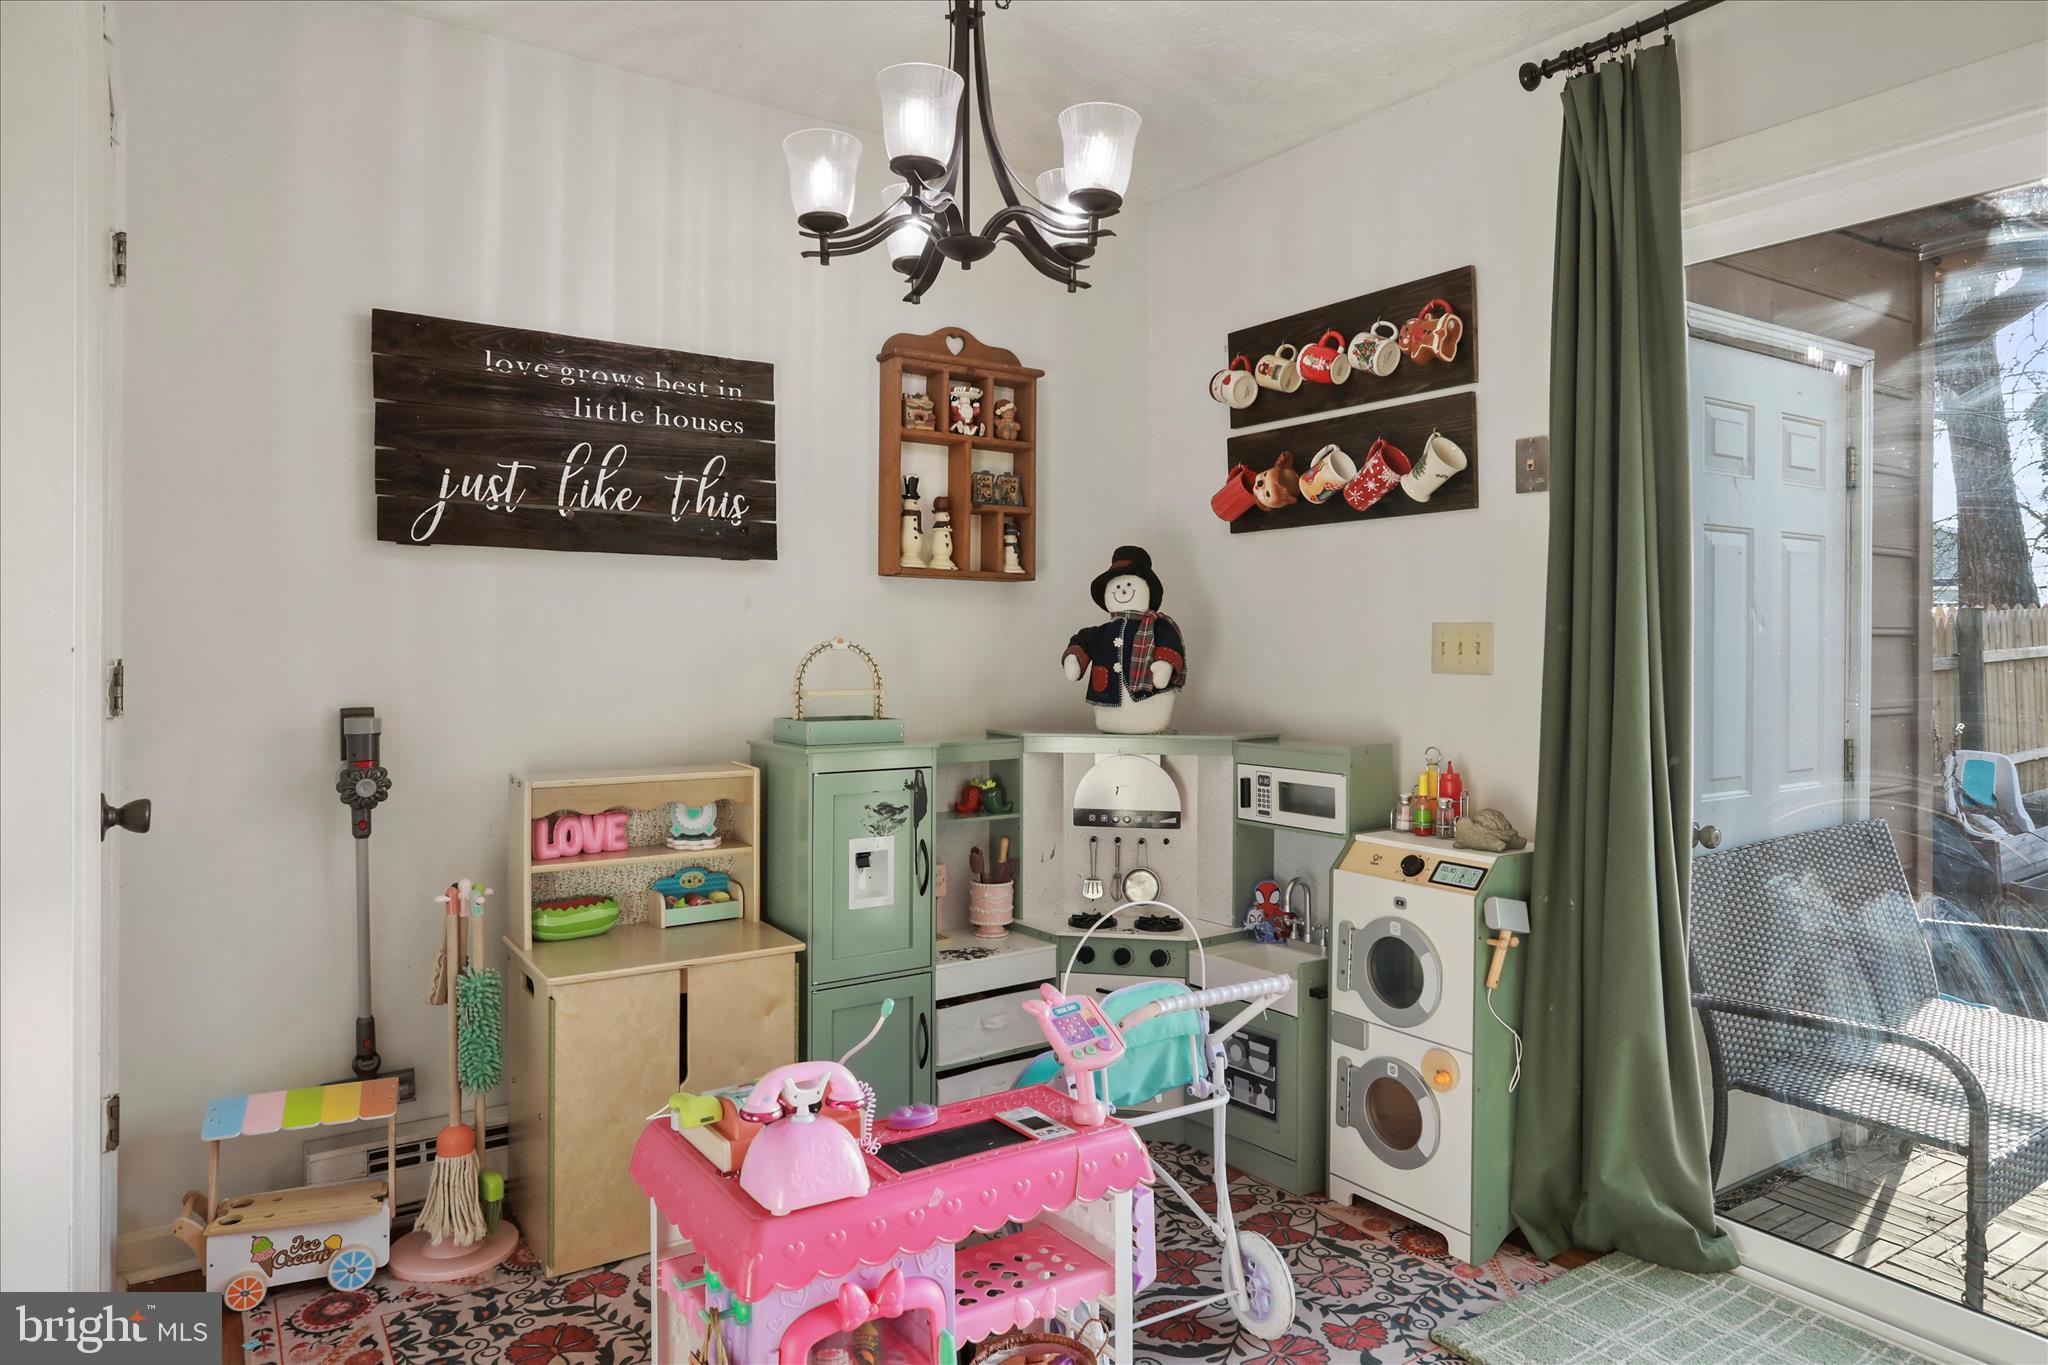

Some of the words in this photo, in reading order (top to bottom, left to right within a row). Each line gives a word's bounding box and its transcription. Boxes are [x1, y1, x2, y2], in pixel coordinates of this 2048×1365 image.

[485, 350, 549, 378] love
[561, 366, 645, 389] grows
[655, 372, 709, 398] best
[718, 379, 743, 401] in
[573, 397, 644, 424] little
[654, 406, 744, 434] houses
[411, 461, 536, 541] just
[558, 442, 641, 517] like
[665, 455, 749, 526] this
[532, 811, 629, 860] LOVE
[272, 1249, 331, 1269] Cream
[290, 1234, 321, 1254] Ice
